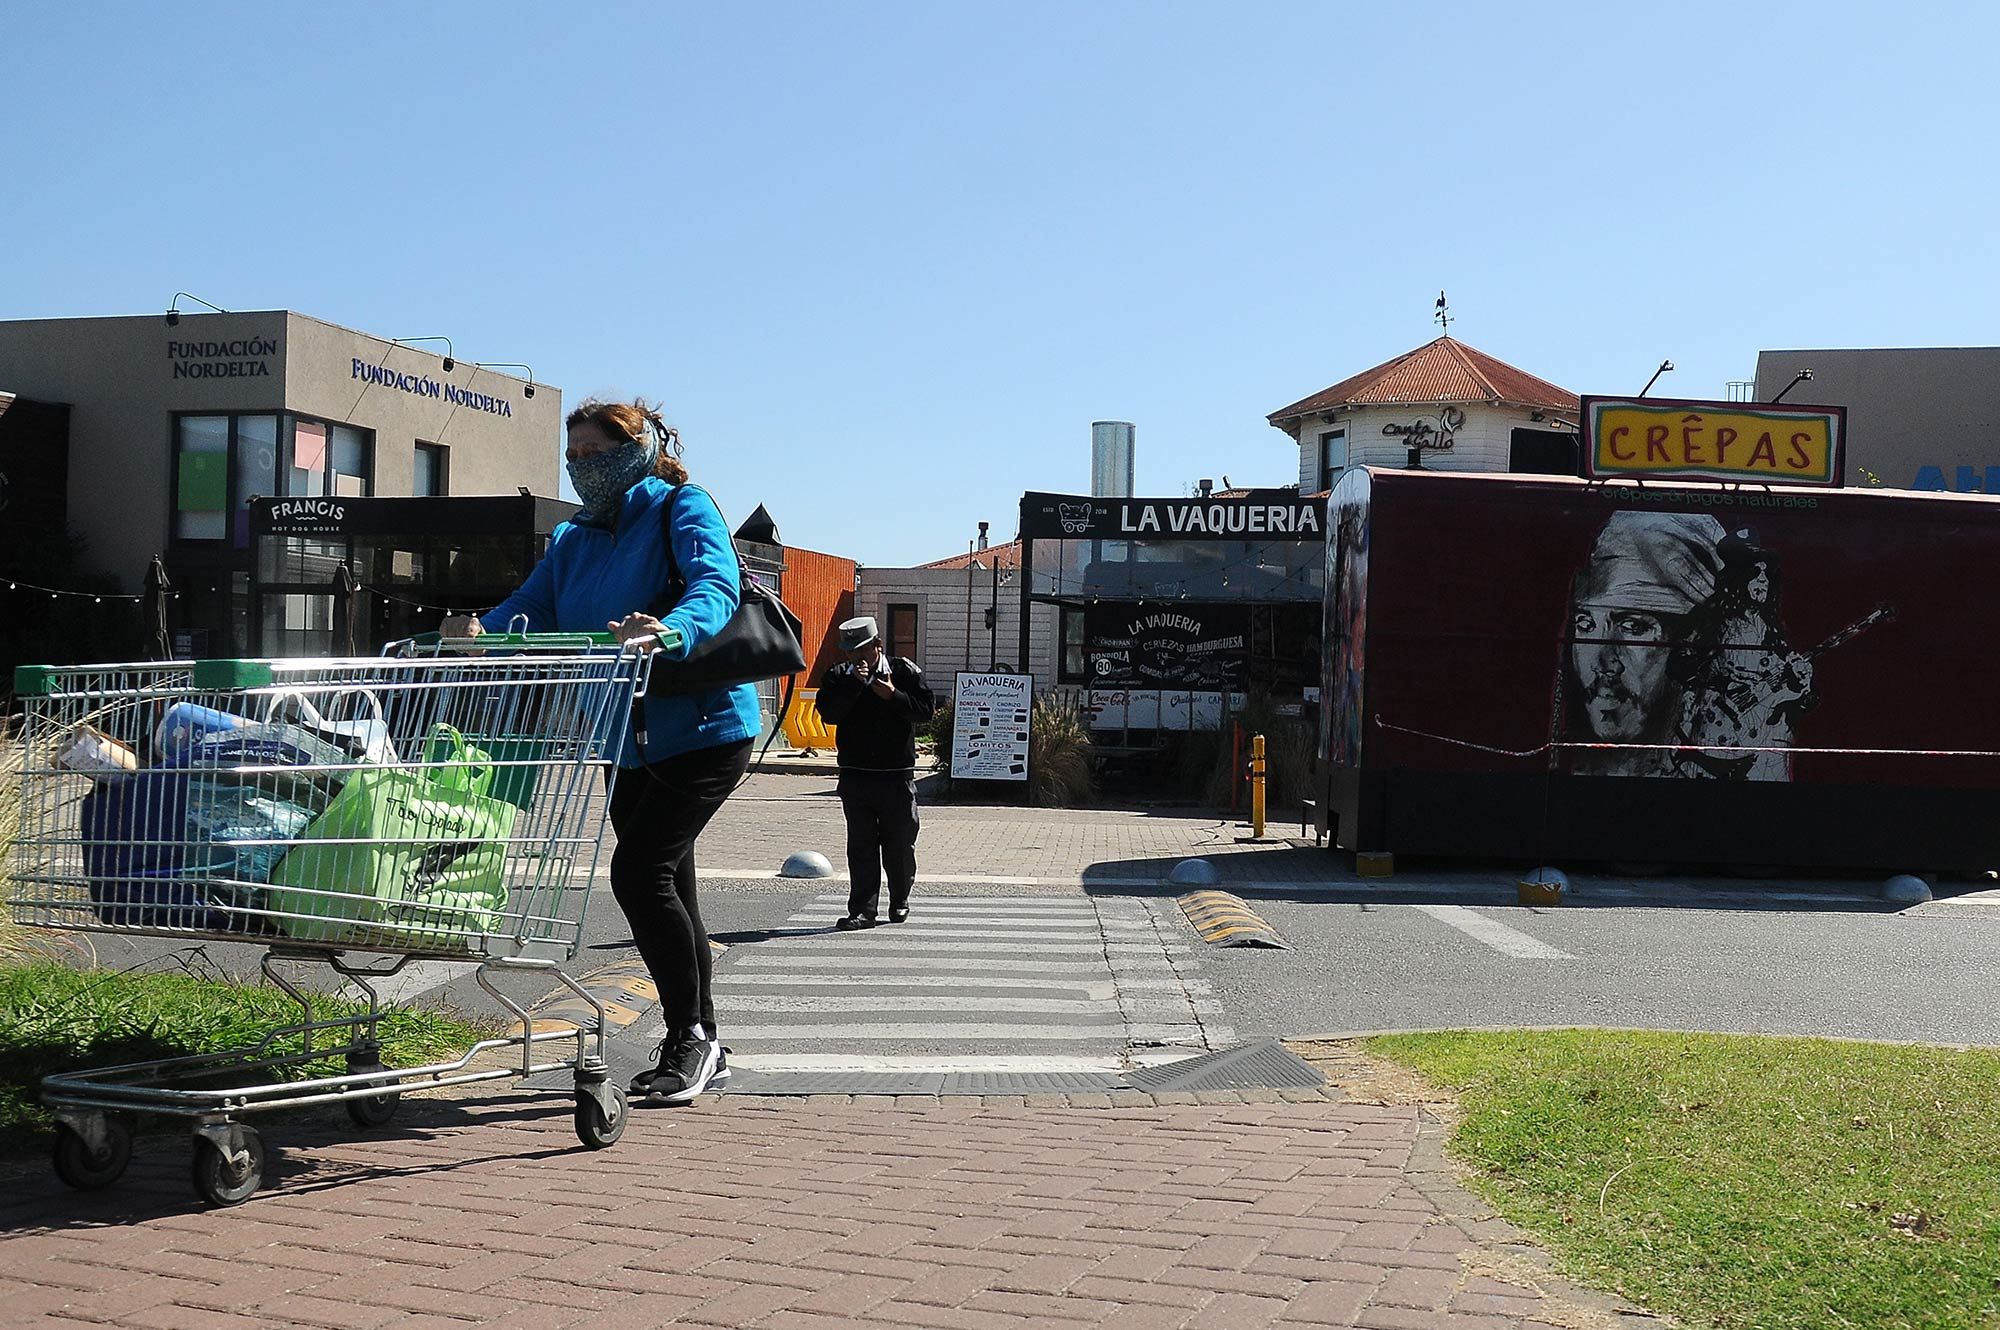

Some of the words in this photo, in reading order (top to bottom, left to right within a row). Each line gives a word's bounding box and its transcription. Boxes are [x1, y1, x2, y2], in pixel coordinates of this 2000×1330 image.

[167, 336, 277, 359] FUNDACIÓN
[172, 361, 269, 379] NORDELTA
[351, 357, 440, 400] FUNDACIÓN
[443, 382, 512, 418] NORDELTA
[1609, 414, 1812, 469] CRÊPAS
[1685, 489, 1734, 506] jugos
[1739, 494, 1818, 509] naturales
[271, 500, 344, 520] FRANCIS
[1121, 505, 1160, 532] LA
[1167, 505, 1319, 535] VAQUERIA
[1128, 620, 1144, 635] LA
[1145, 613, 1201, 636] VAQUERIA
[1090, 650, 1130, 663] BONDIOLA
[1098, 661, 1111, 672] 80
[961, 679, 975, 689] LA
[975, 676, 1025, 693] VAQUERIA
